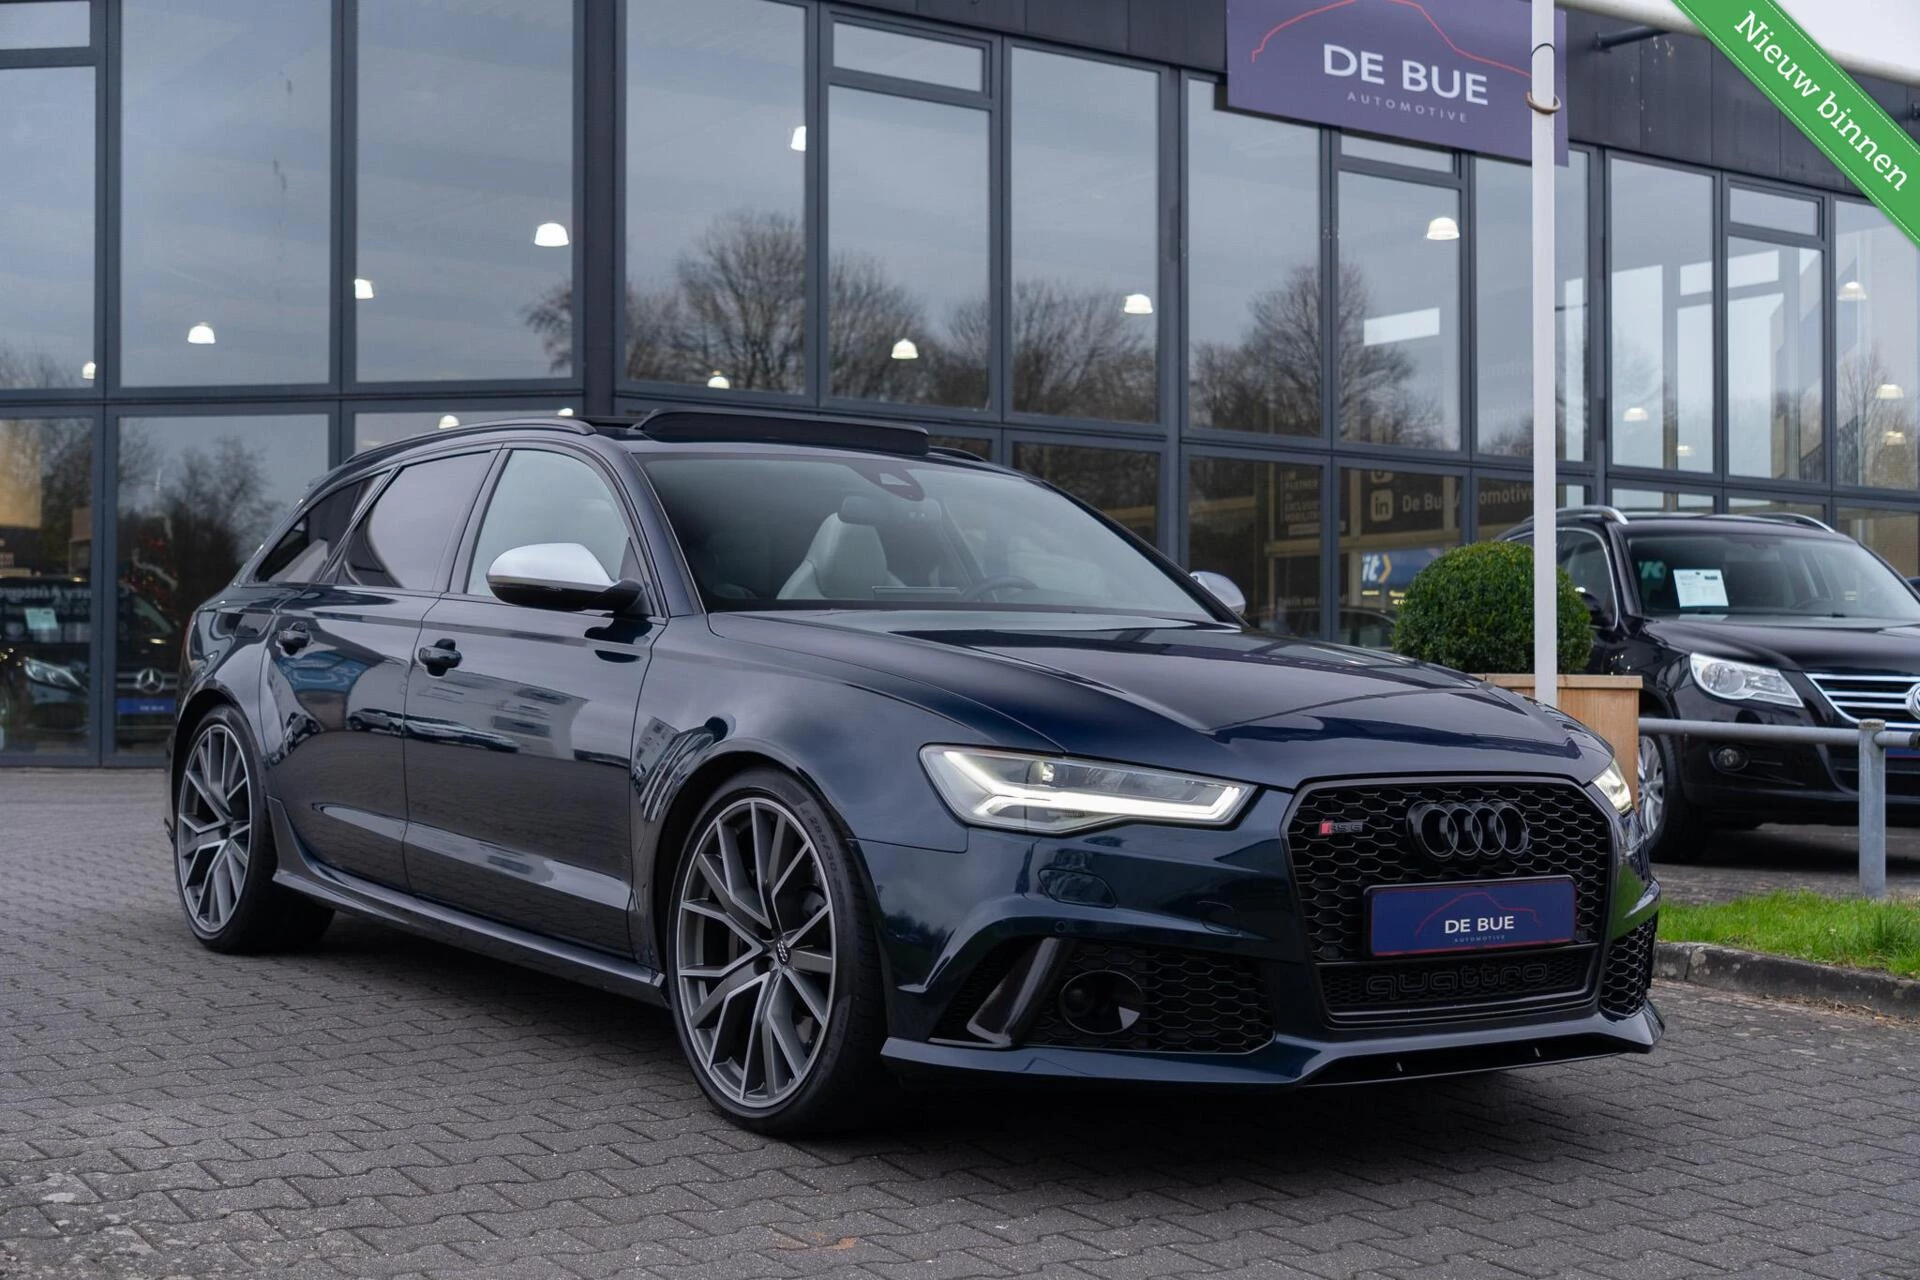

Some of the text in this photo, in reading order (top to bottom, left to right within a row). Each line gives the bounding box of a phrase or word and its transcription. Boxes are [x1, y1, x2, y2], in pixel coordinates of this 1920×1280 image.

[1323, 43, 1489, 105] DE BUE
[1347, 91, 1469, 123] AUTOMOTIVE
[1402, 494, 1421, 512] De
[1444, 915, 1515, 934] DE BUE
[1454, 934, 1505, 943] AUTOMOTIVE
[1367, 963, 1548, 1001] quattro
